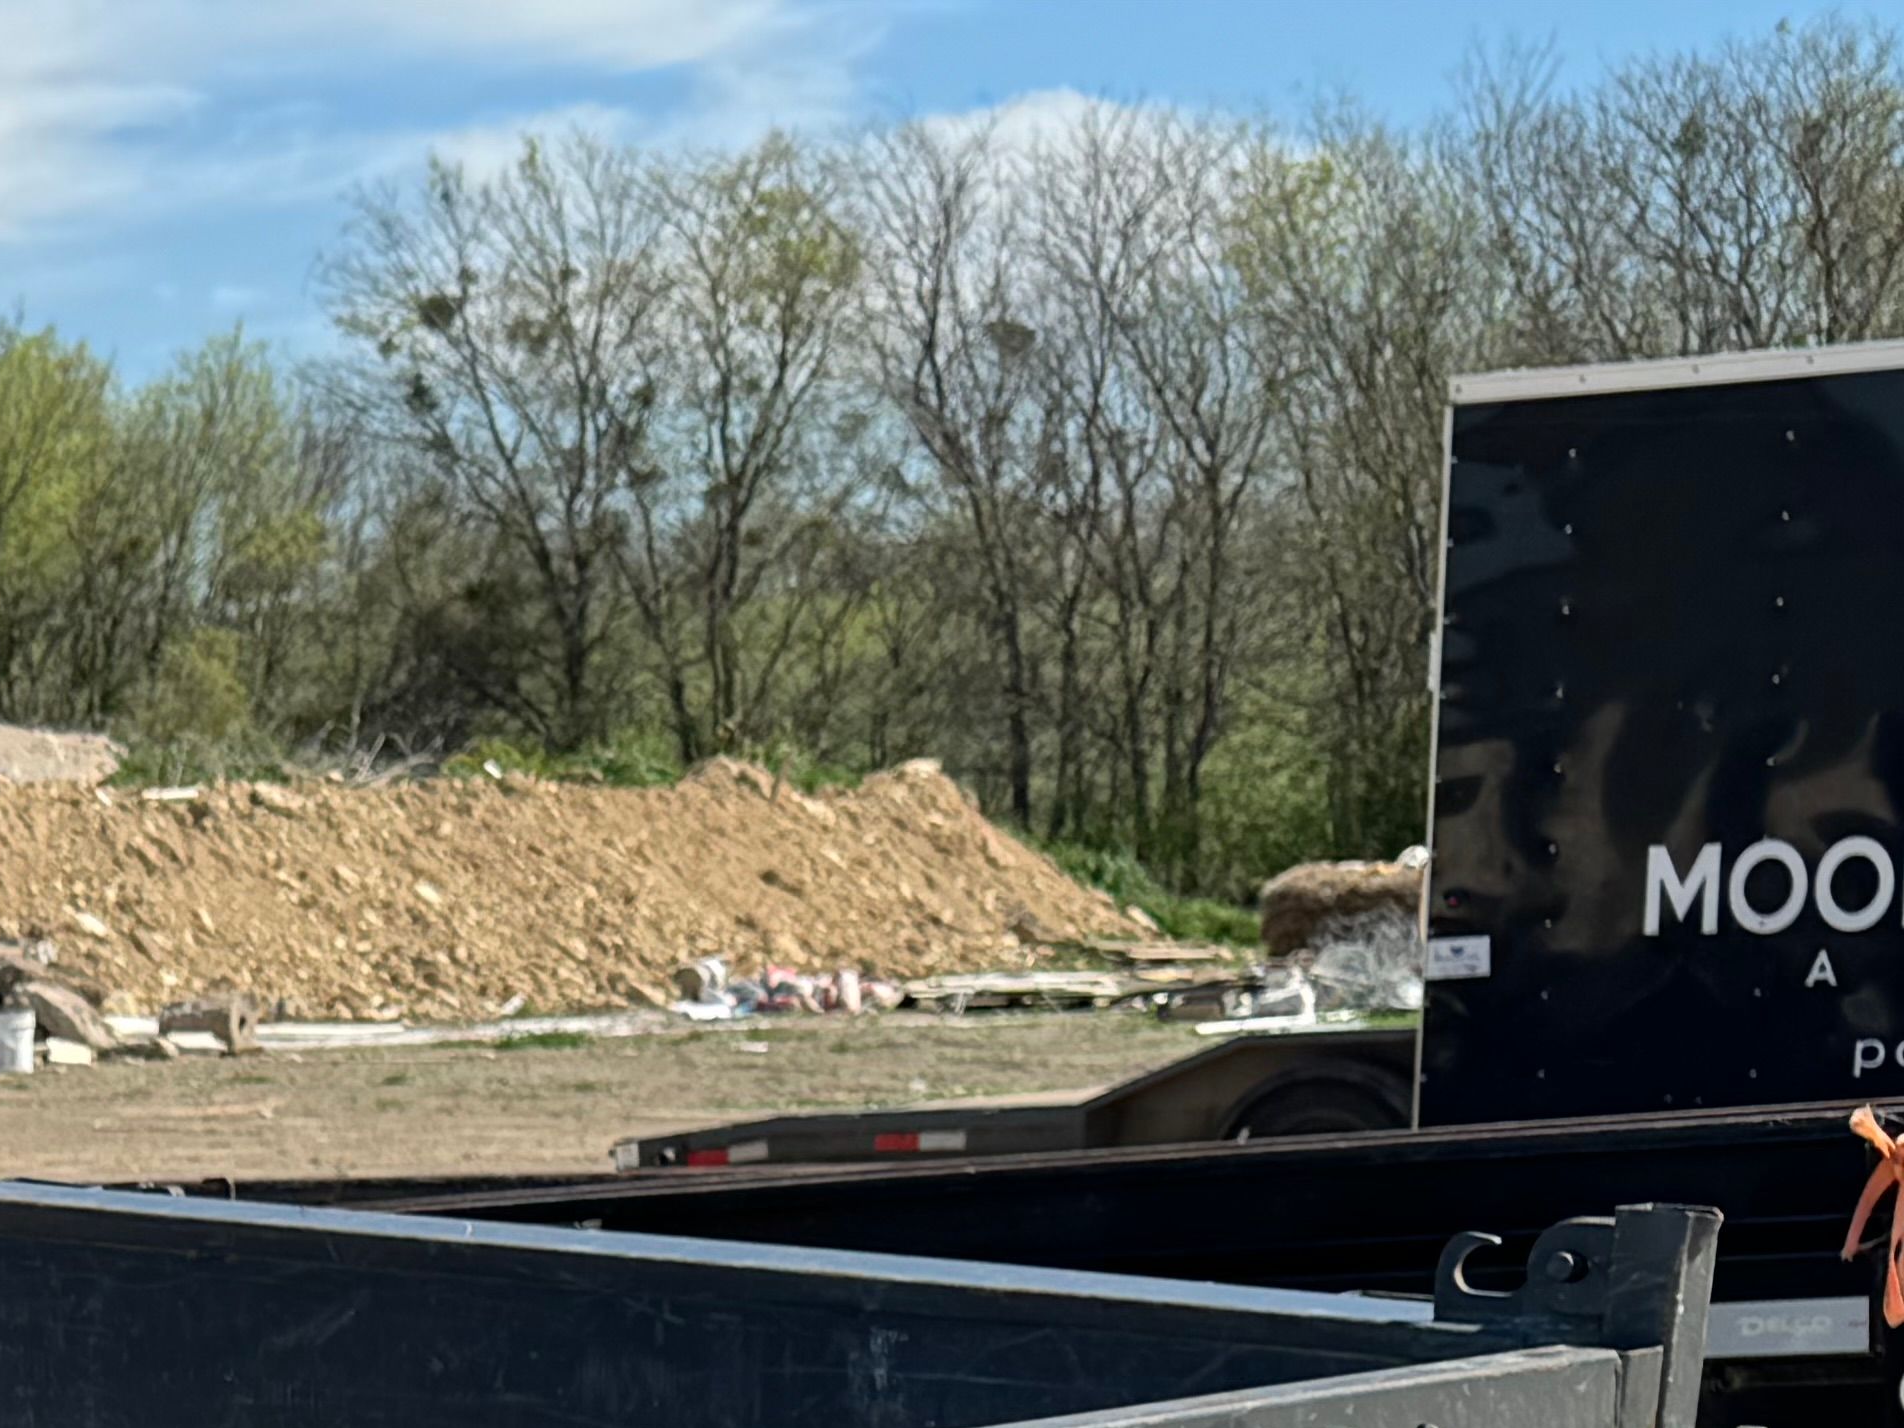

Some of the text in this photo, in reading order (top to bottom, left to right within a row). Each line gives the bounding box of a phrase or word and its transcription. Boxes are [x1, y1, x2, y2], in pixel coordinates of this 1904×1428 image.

[1643, 835, 1904, 937] MOO
[1804, 948, 1838, 988] A
[1852, 1037, 1904, 1079] p
